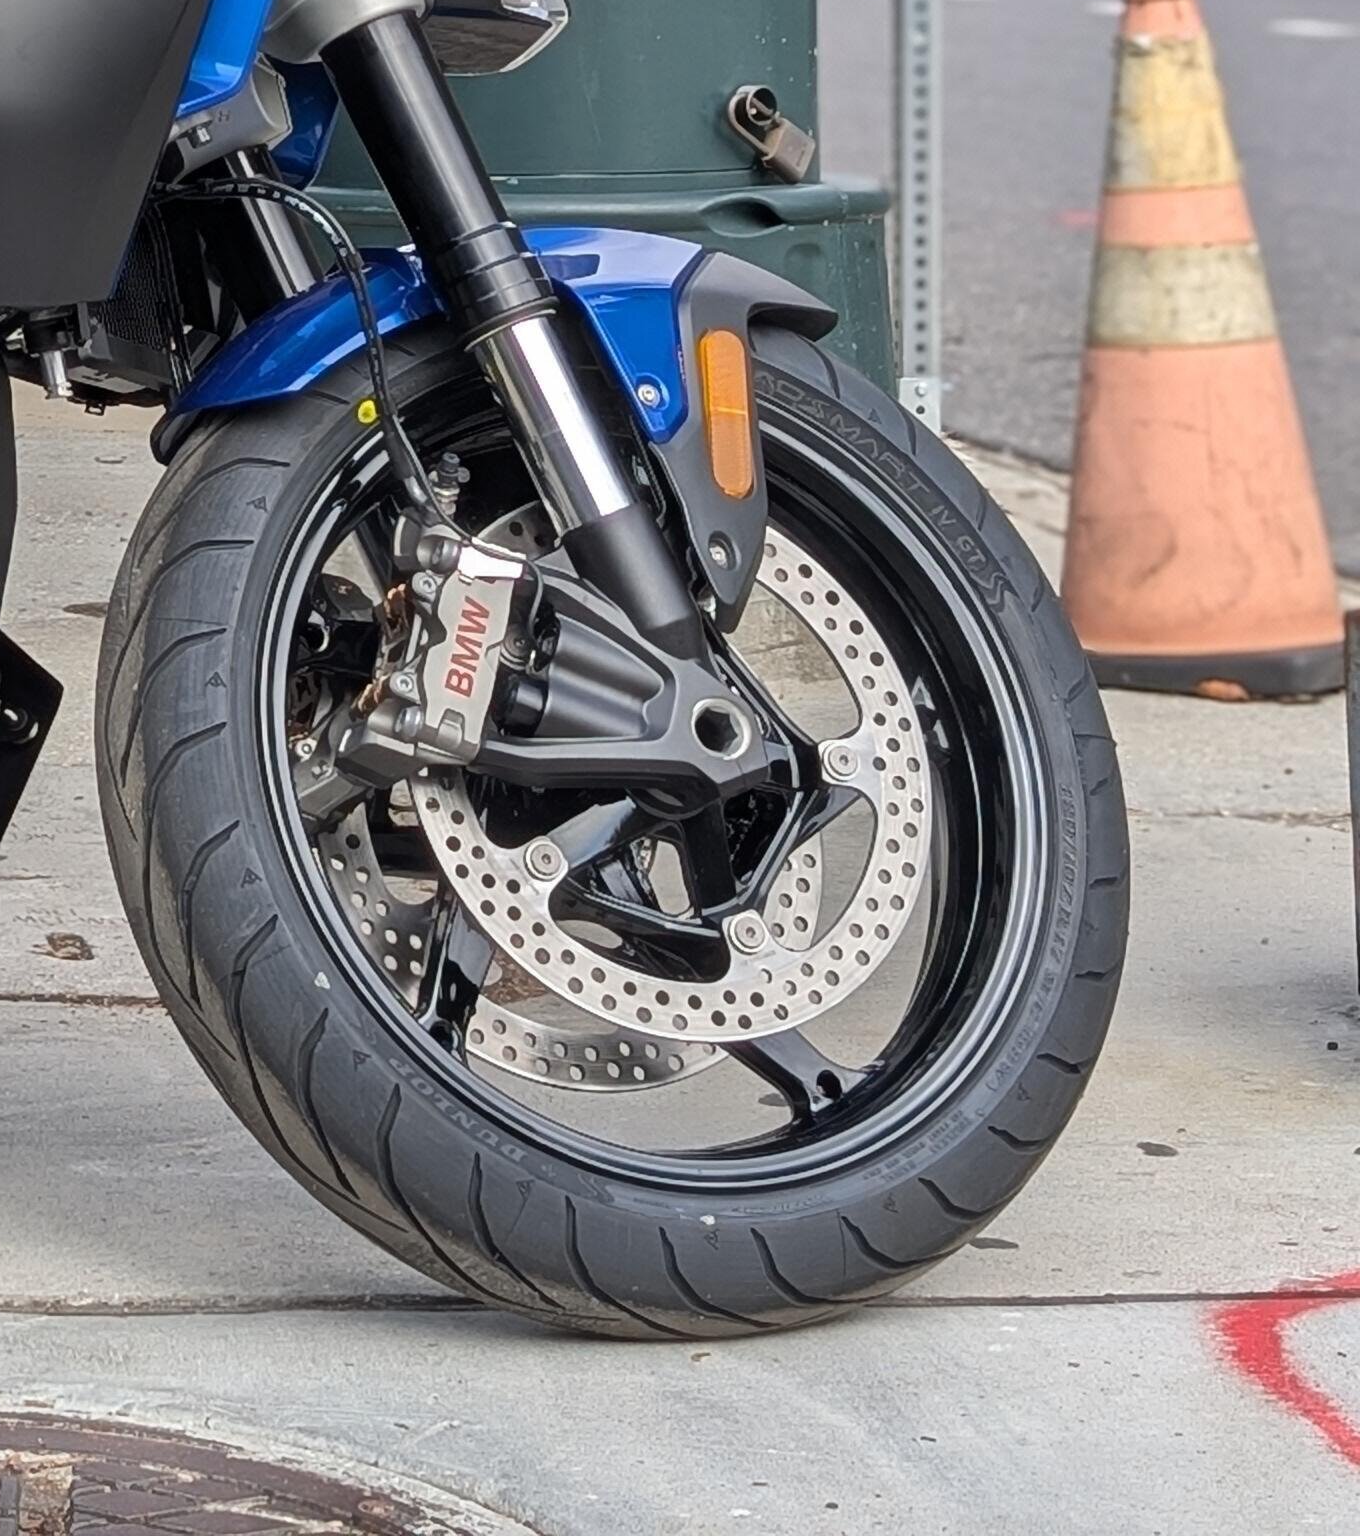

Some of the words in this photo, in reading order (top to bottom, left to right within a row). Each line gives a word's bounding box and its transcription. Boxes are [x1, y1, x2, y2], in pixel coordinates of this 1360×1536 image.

[931, 504, 957, 527] IV
[956, 534, 987, 565] GT
[444, 595, 491, 699] BMW
[388, 1056, 529, 1163] DUNLOP
